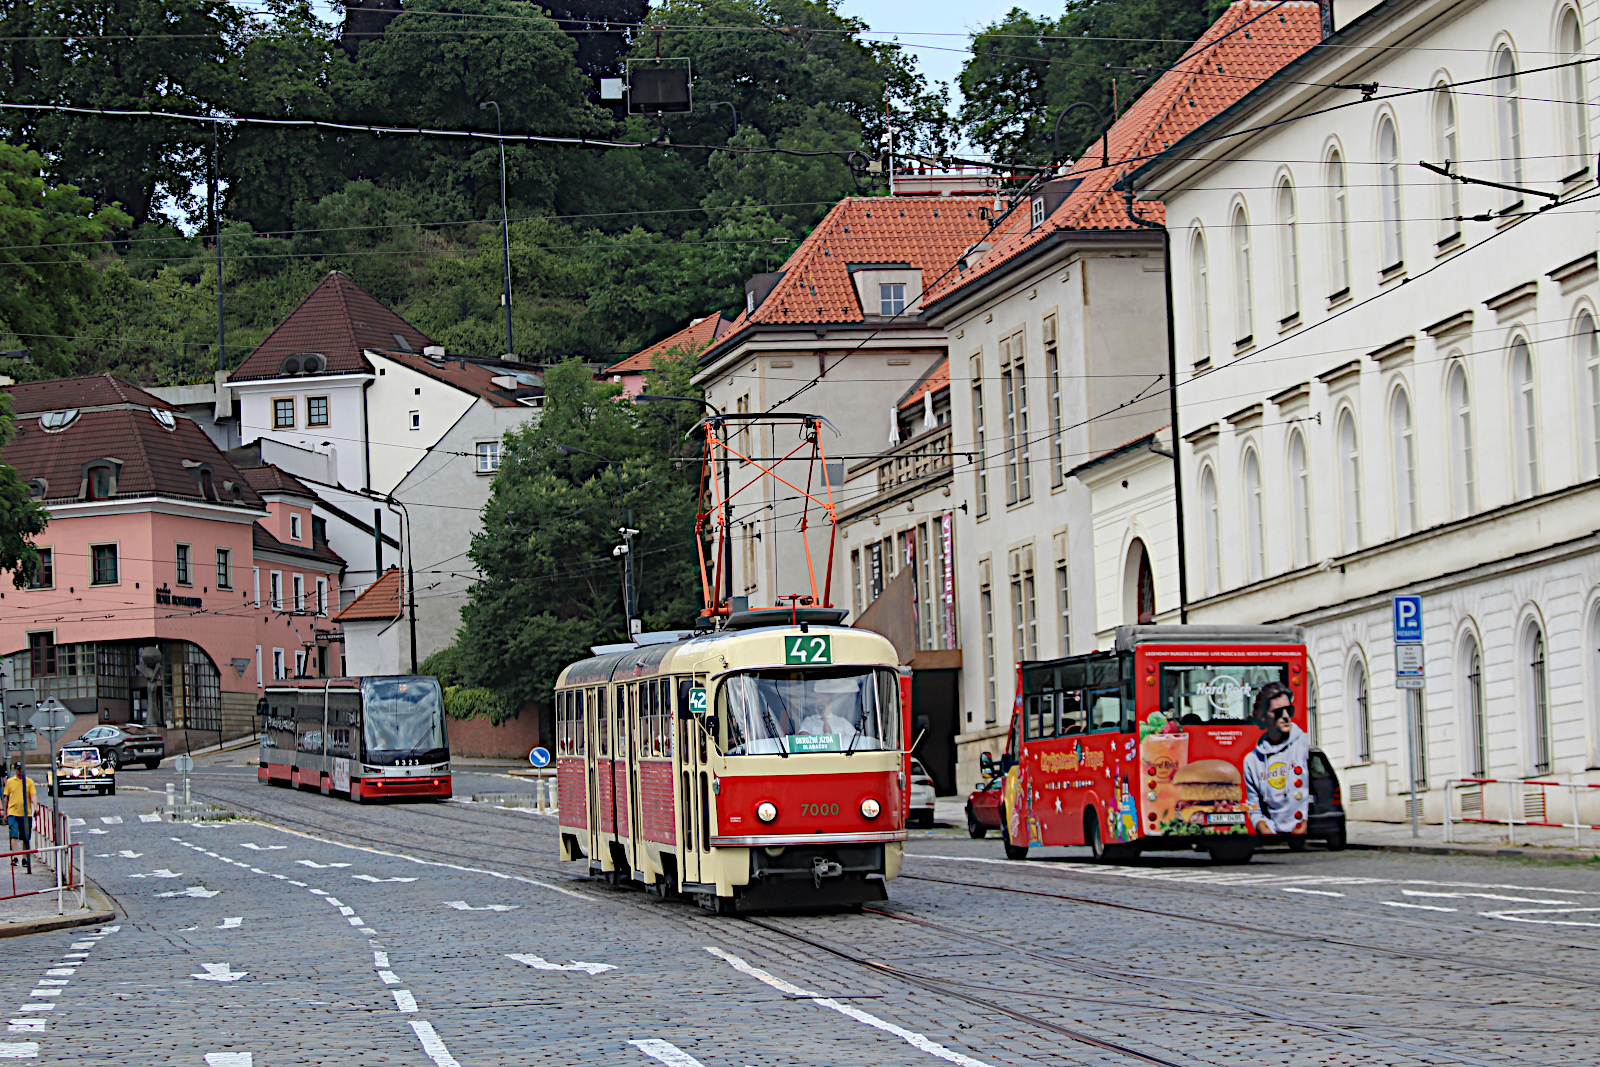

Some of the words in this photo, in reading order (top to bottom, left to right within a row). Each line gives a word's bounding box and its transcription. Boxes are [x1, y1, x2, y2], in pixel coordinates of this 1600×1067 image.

[1399, 601, 1416, 628] P
[790, 637, 828, 662] 42
[175, 664, 183, 718] HOTEL
[1196, 682, 1225, 695] Hard
[1225, 682, 1251, 697] Rock
[690, 692, 706, 708] 42
[801, 803, 840, 817] 7000
